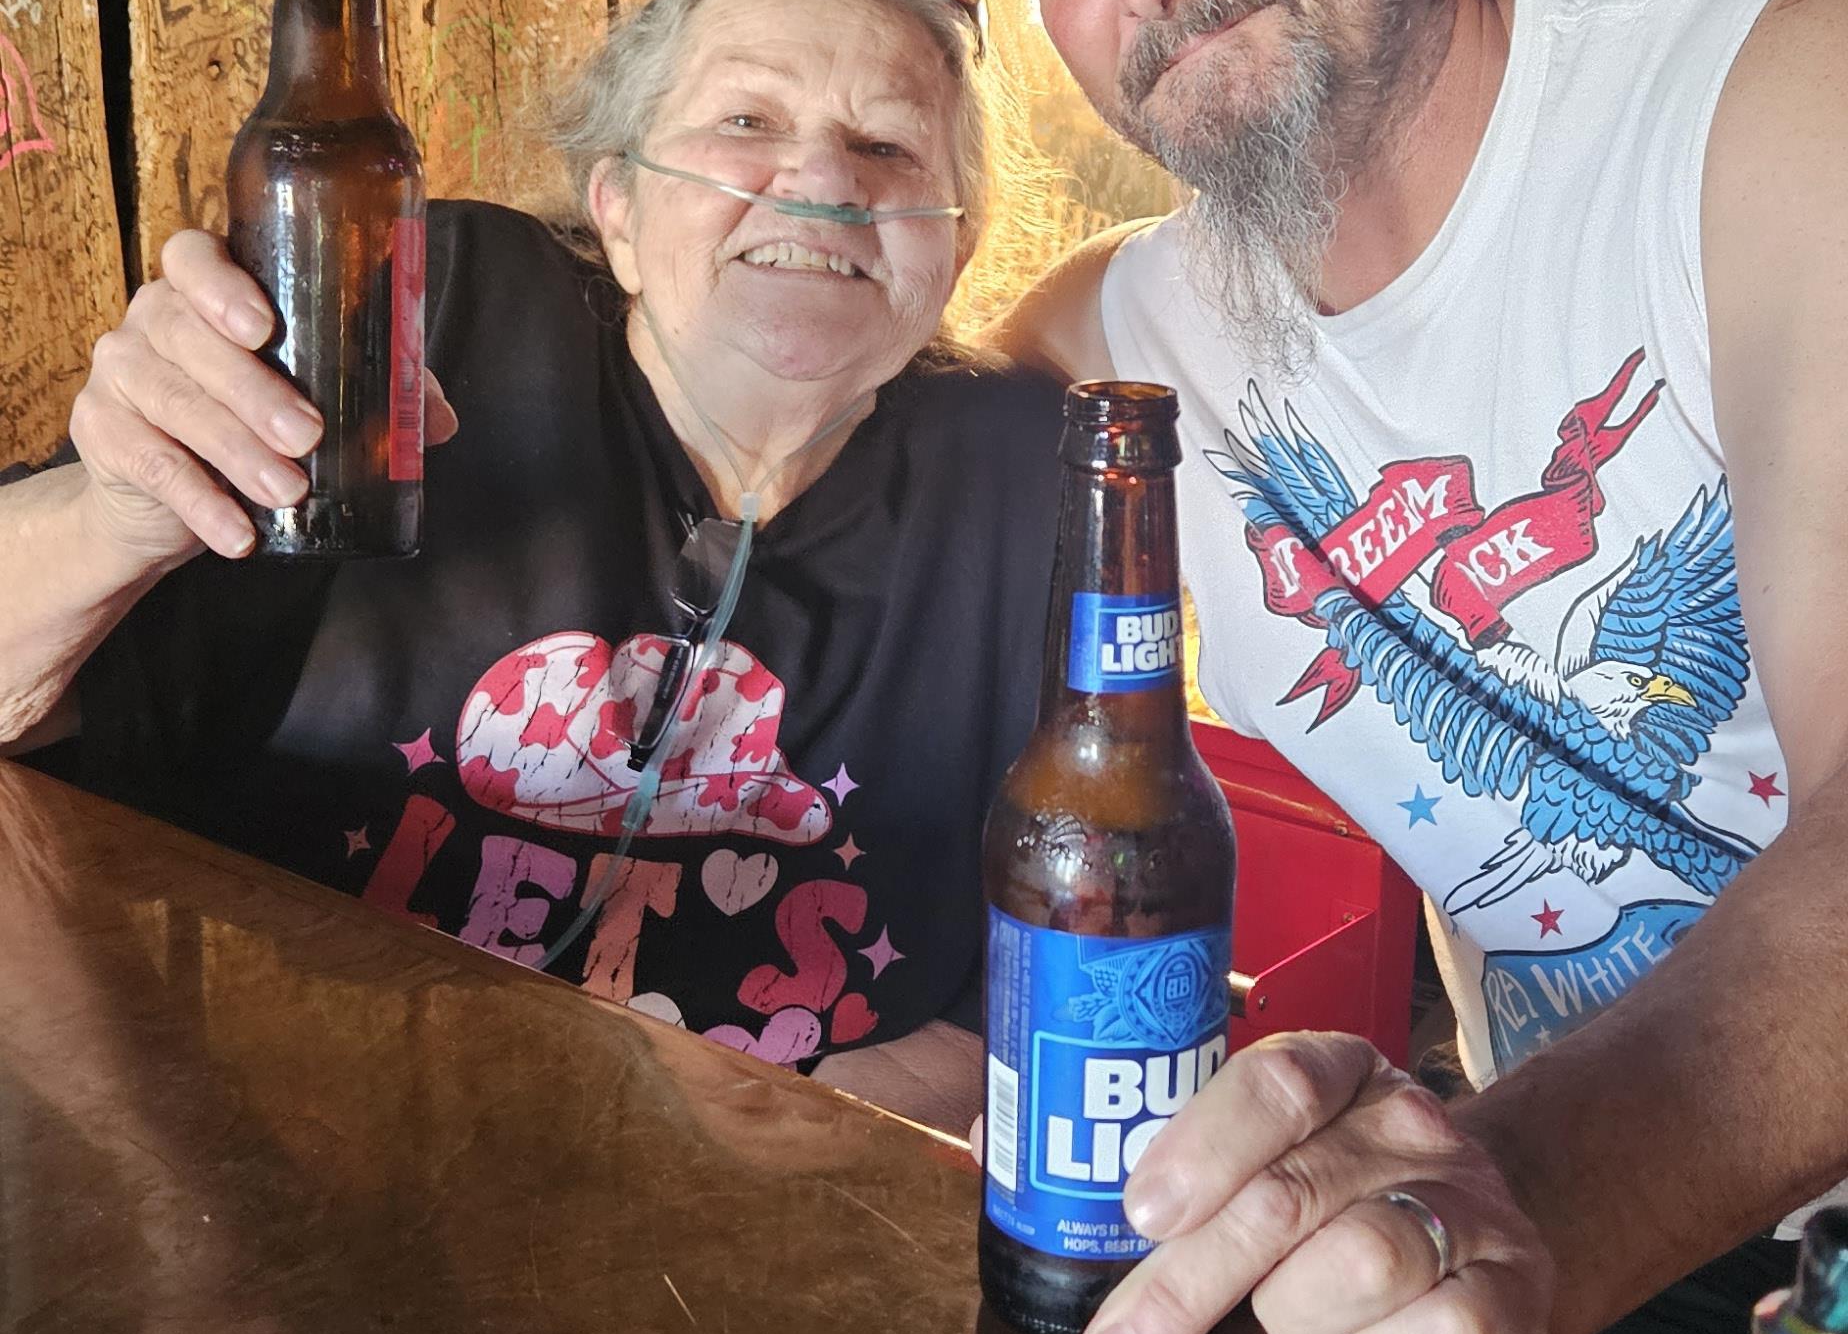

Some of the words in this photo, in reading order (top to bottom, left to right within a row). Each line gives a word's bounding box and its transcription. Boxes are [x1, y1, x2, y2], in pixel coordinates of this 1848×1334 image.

[1116, 609, 1179, 645] BUD
[1100, 641, 1179, 673] LIGH
[1529, 920, 1674, 1019] WHITE
[1056, 1218, 1108, 1237] ALWAYS
[1062, 1236, 1102, 1255] HOPS,
[1104, 1238, 1135, 1254] BEST
